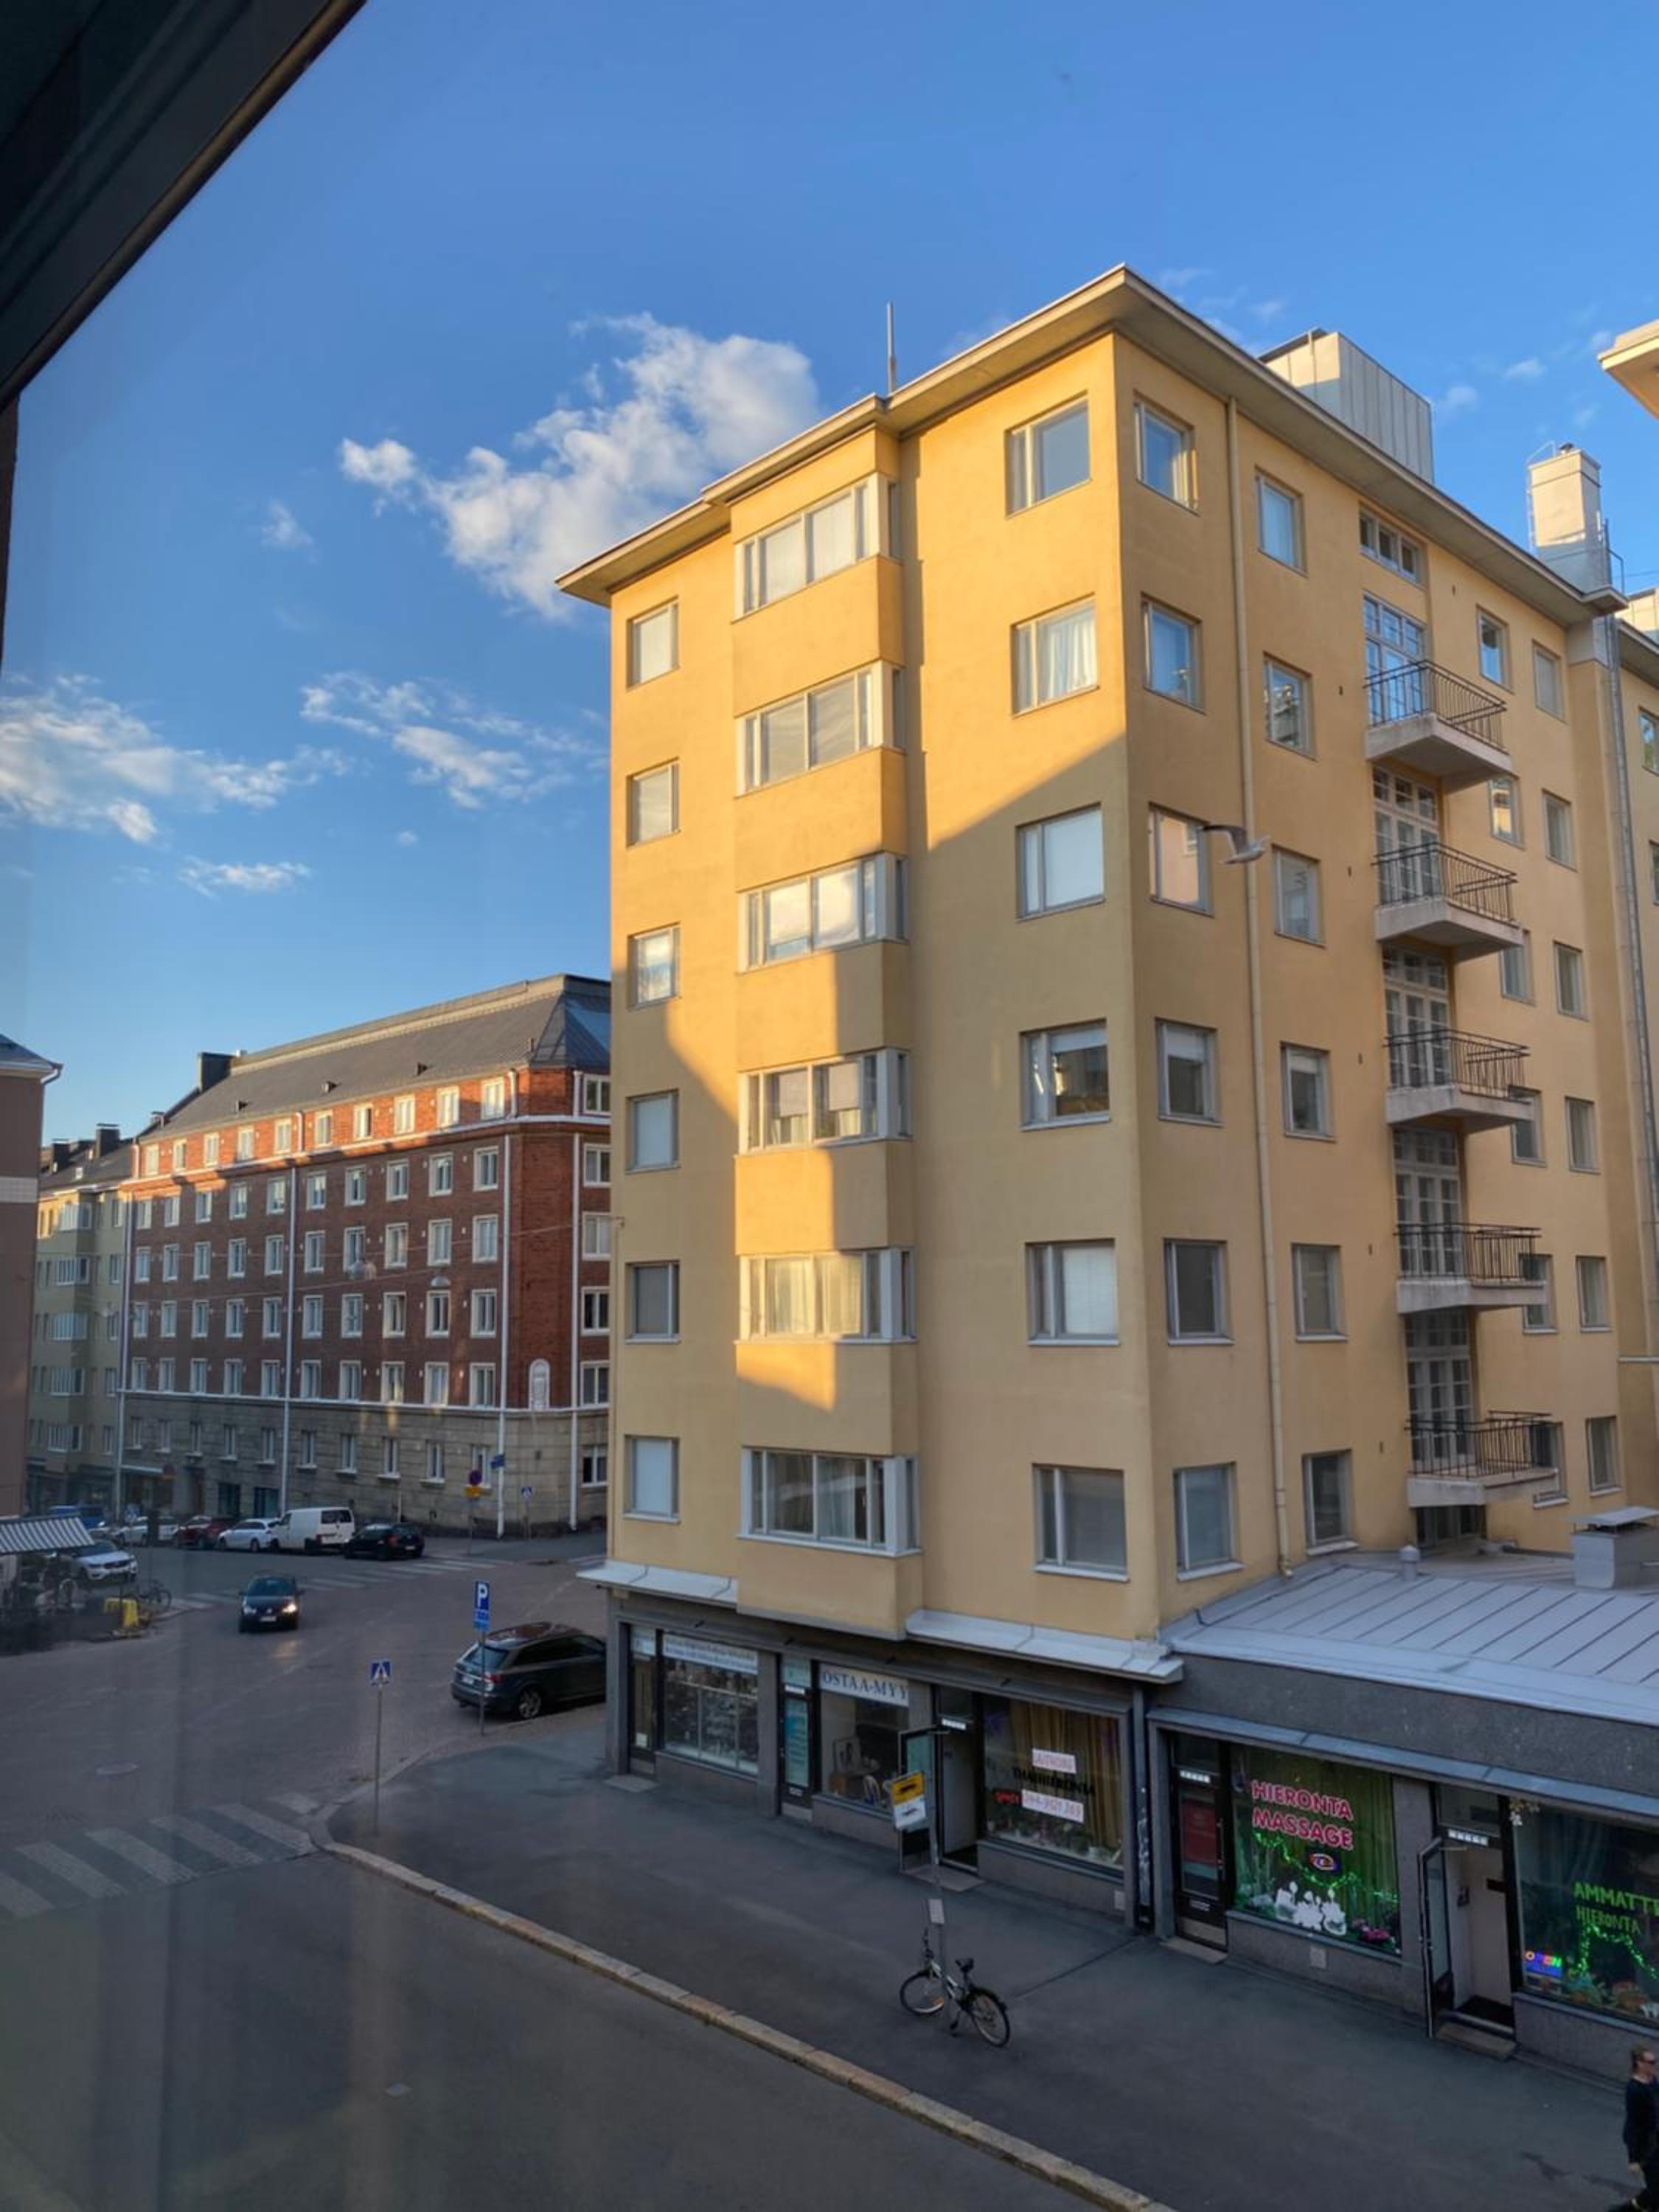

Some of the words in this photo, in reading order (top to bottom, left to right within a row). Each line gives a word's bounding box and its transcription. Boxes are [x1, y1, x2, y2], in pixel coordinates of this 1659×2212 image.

[477, 1583, 488, 1608] P
[1251, 1780, 1353, 1821] HIERONTA
[1252, 1807, 1353, 1851] MASSAGE
[1576, 1905, 1641, 1935] HIERONTA
